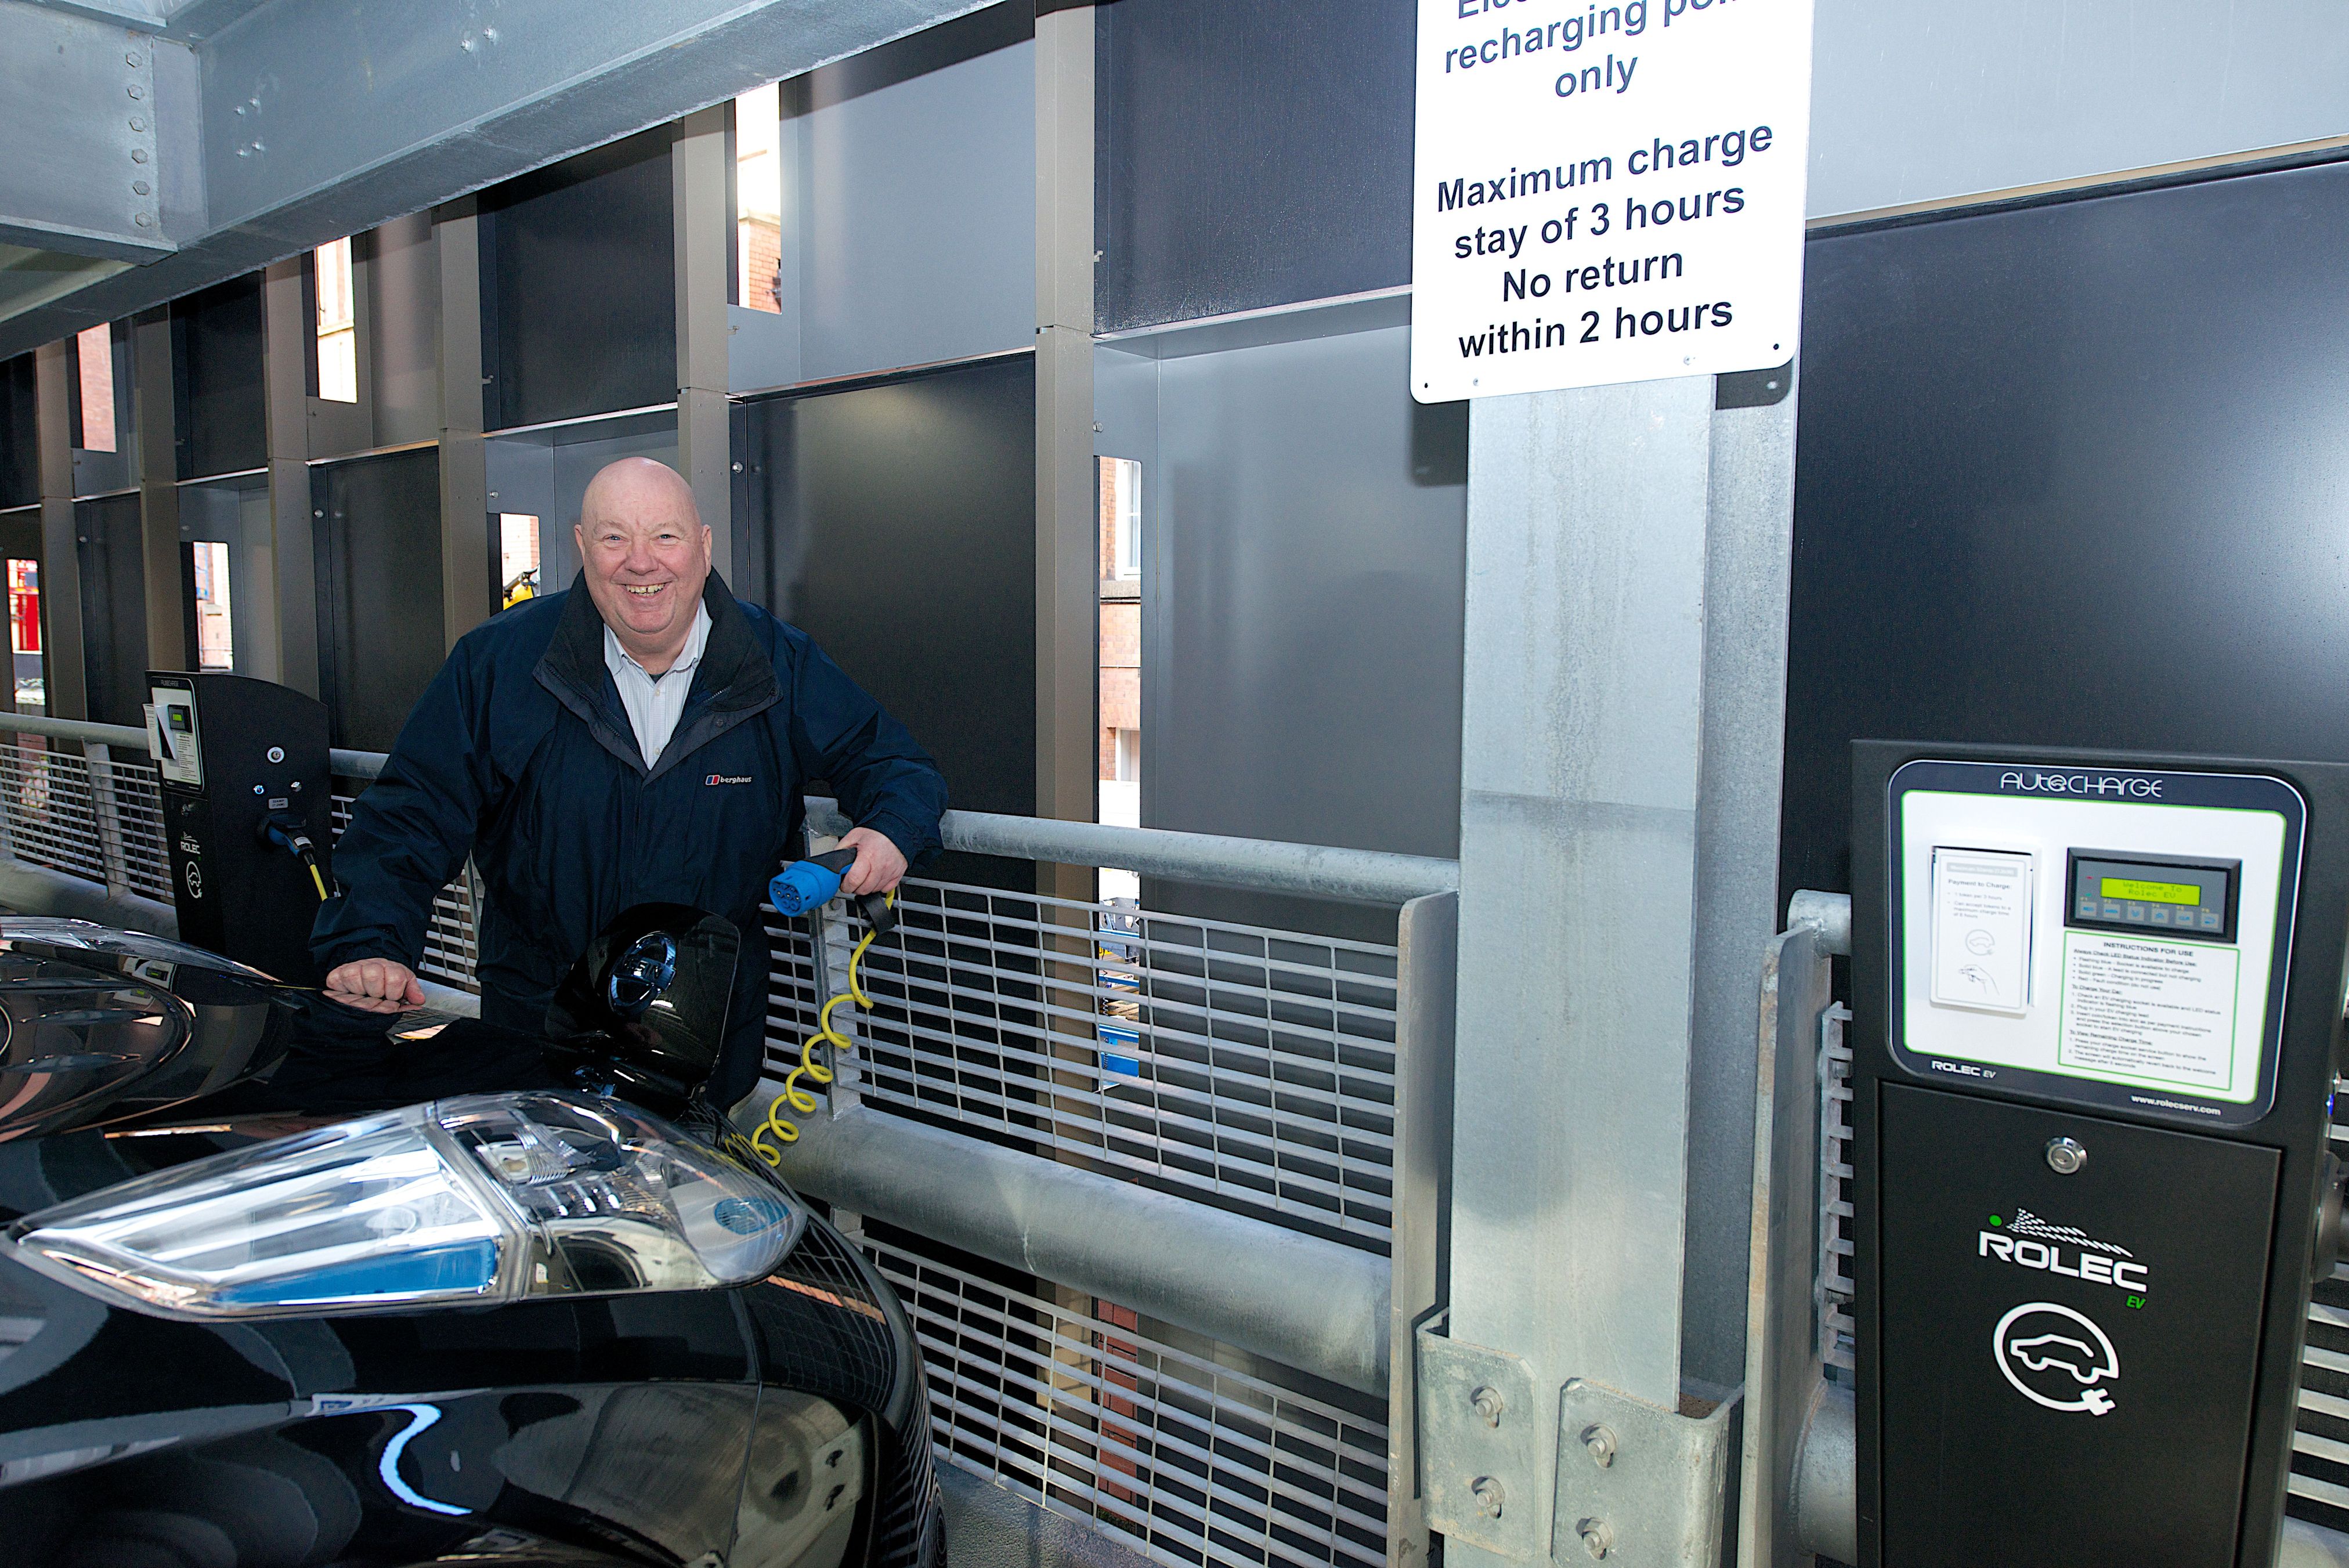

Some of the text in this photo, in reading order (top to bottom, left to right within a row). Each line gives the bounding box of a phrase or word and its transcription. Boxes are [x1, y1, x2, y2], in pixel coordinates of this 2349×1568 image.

[1445, 0, 1647, 74] recharging
[1555, 54, 1638, 97] only
[1438, 125, 1772, 212] Maximum charge
[1455, 187, 1744, 259] stay of 3 hours
[1504, 253, 1682, 302] No return
[1458, 301, 1733, 358] within 2 hours
[2123, 881, 2164, 891] Welcome
[2128, 889, 2157, 898] Rolec
[2104, 942, 2158, 953] INSTRUCTIONS
[1932, 1060, 1996, 1078] ROLEC EV
[2131, 1095, 2221, 1115] www.rolecserv.com
[1979, 1231, 2148, 1292] ROLEC
[2126, 1295, 2146, 1309] EV
